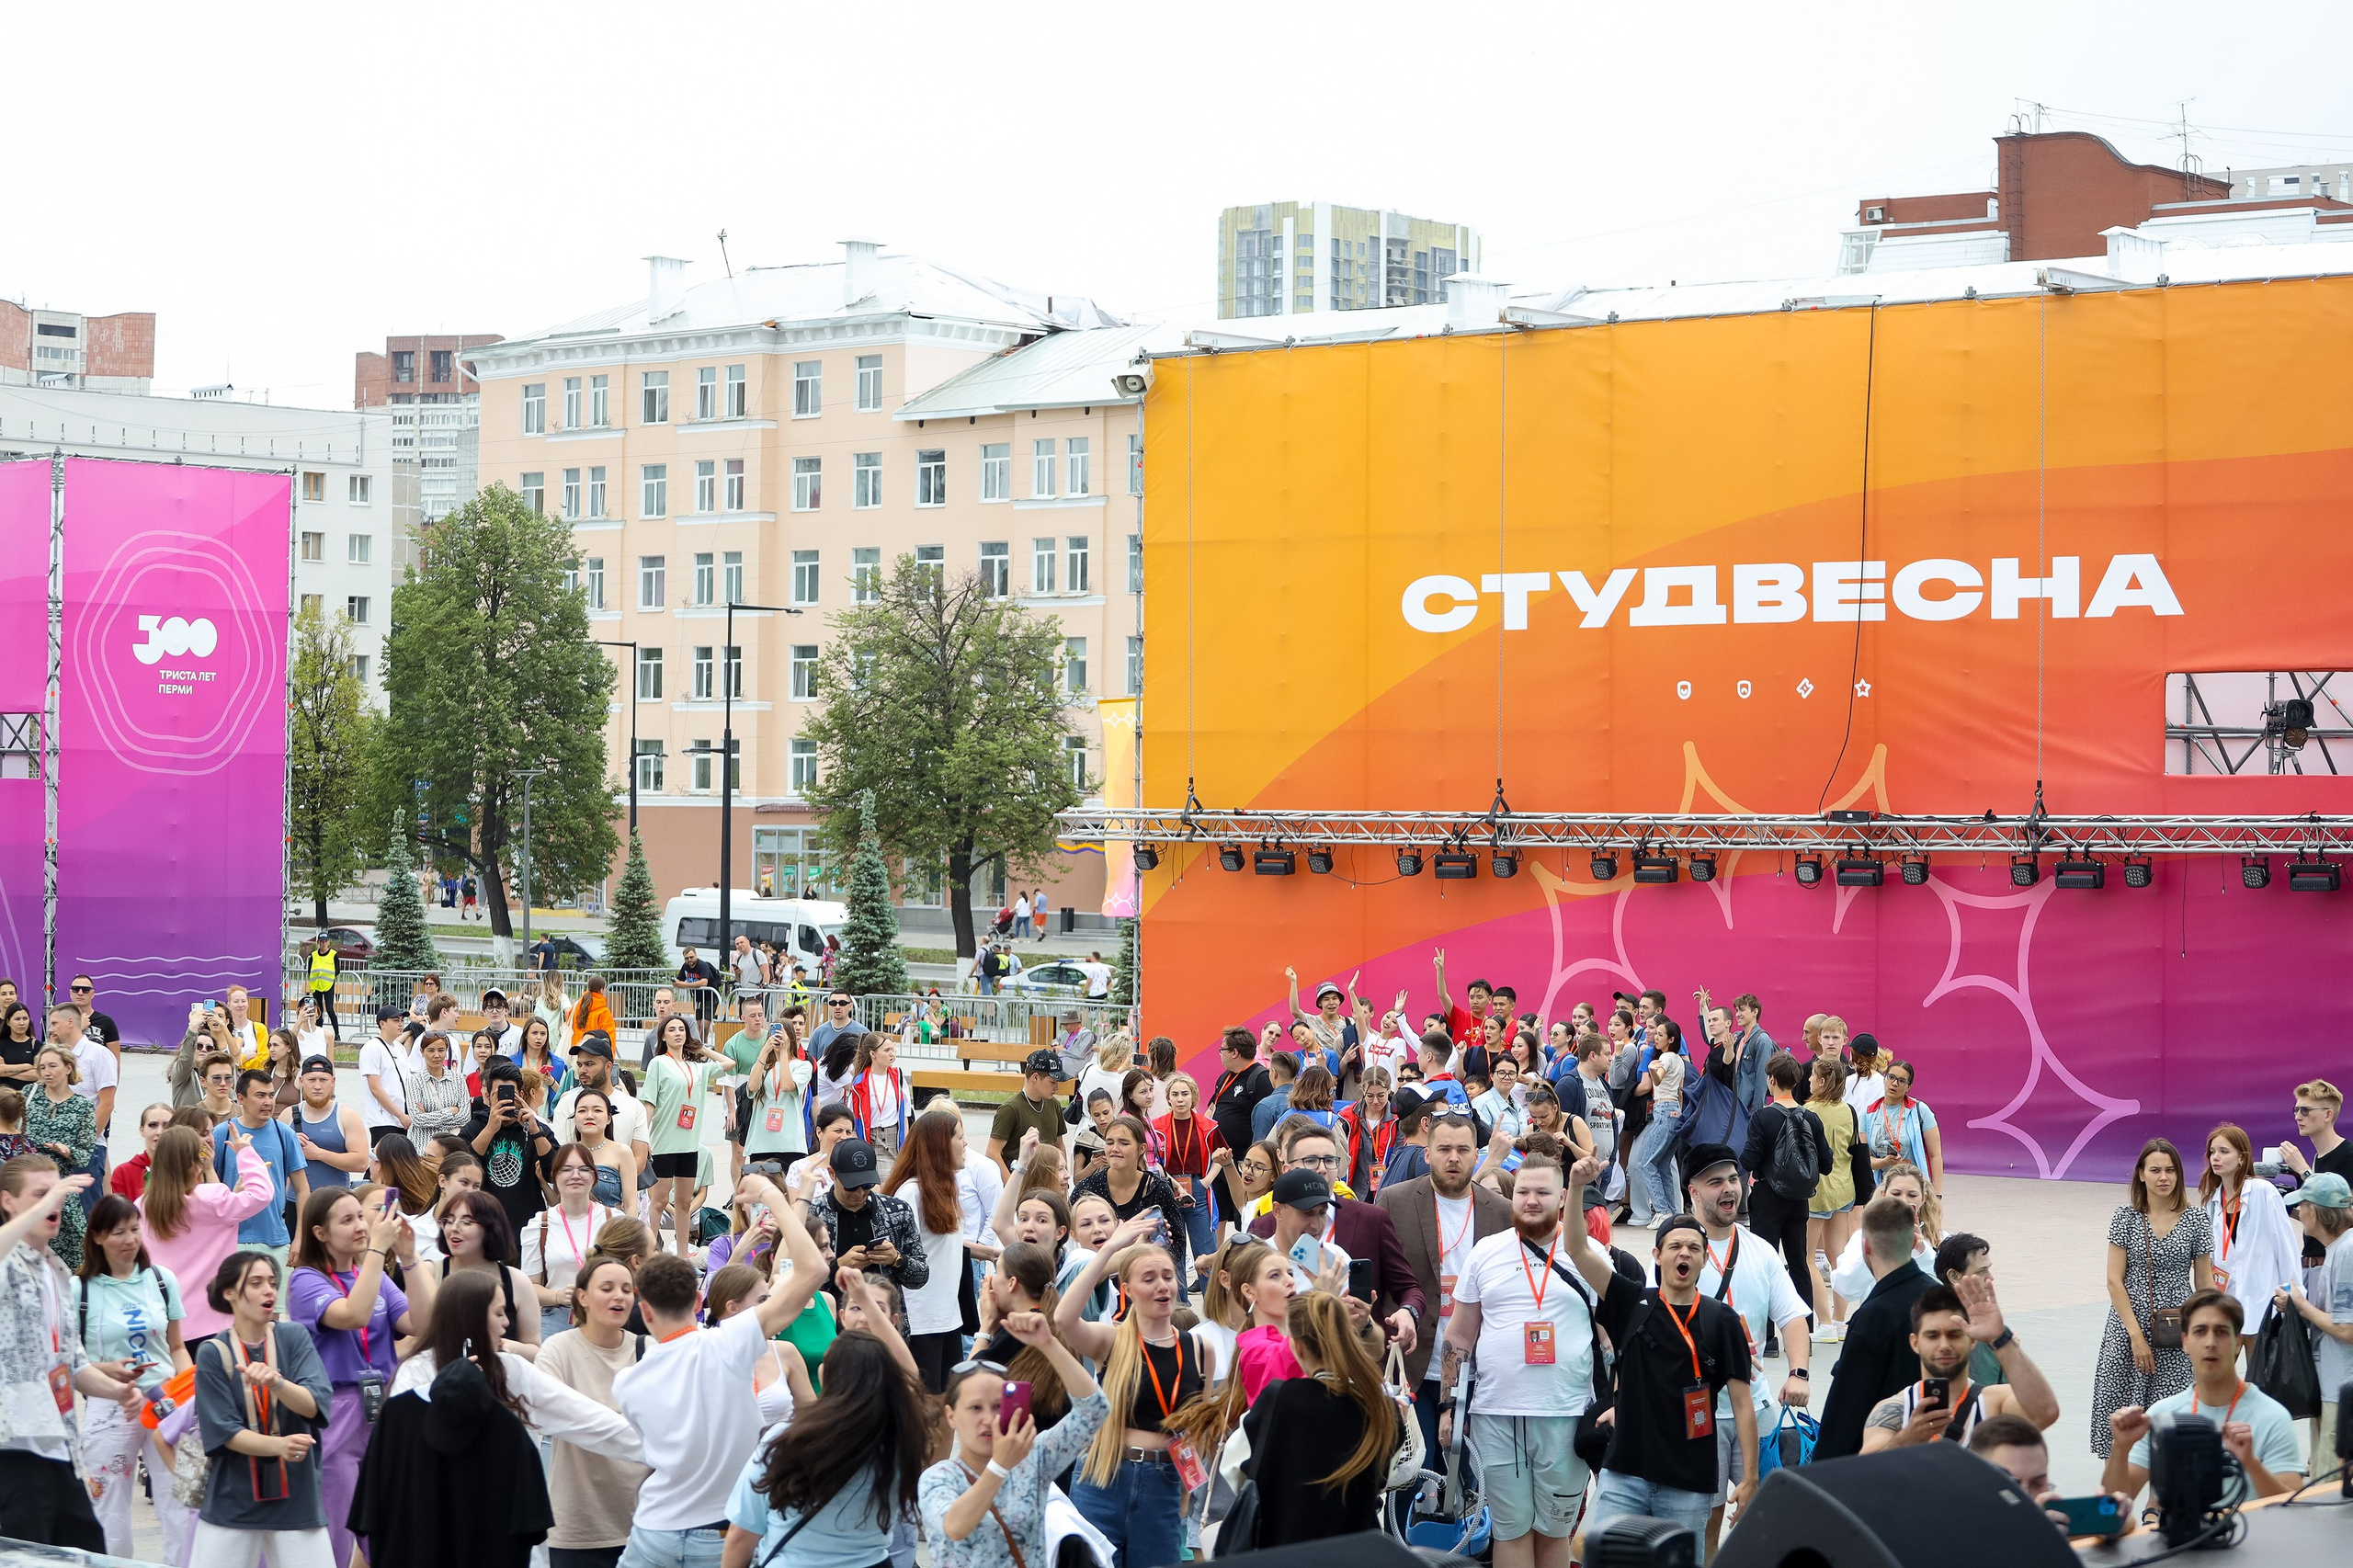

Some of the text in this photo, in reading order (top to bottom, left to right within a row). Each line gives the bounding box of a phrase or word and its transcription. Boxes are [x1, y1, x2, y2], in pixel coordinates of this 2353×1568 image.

[1402, 554, 2185, 633] СТУДВЕСНА
[132, 615, 218, 665] 300
[158, 684, 193, 695] ПЕРМИ
[159, 670, 216, 681] ТРИСТА ЛЕТ
[1303, 1181, 1326, 1191] HDN
[123, 1310, 151, 1366] NICE
